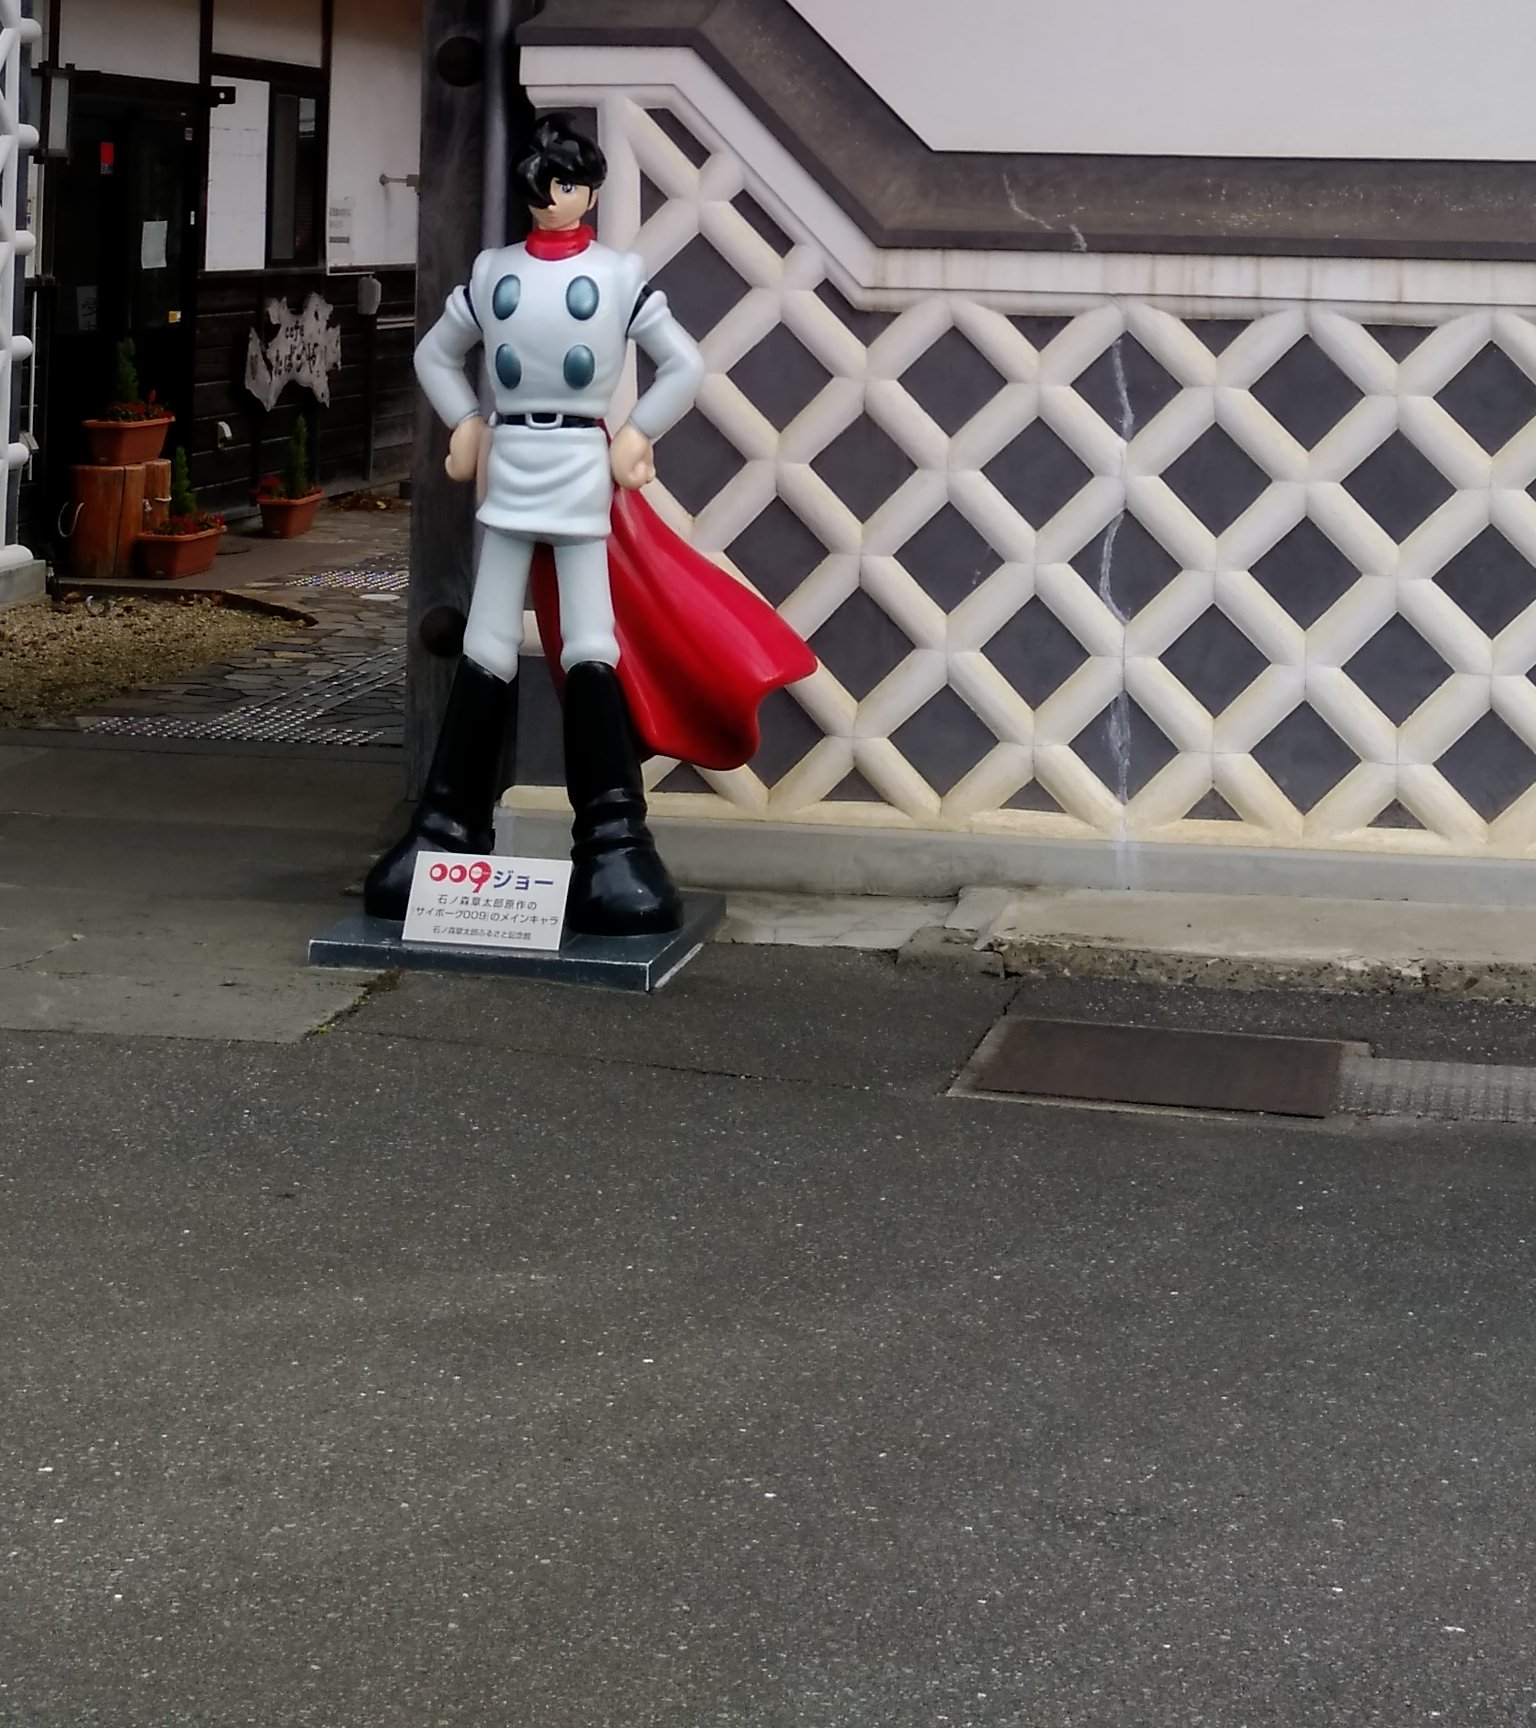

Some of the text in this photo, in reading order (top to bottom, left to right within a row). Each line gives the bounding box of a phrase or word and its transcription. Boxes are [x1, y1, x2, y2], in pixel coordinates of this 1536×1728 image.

[437, 894, 537, 911] 石ノ森章太郎原作の
[432, 925, 531, 941] 石ノ森章太郎ふるさと記念館
